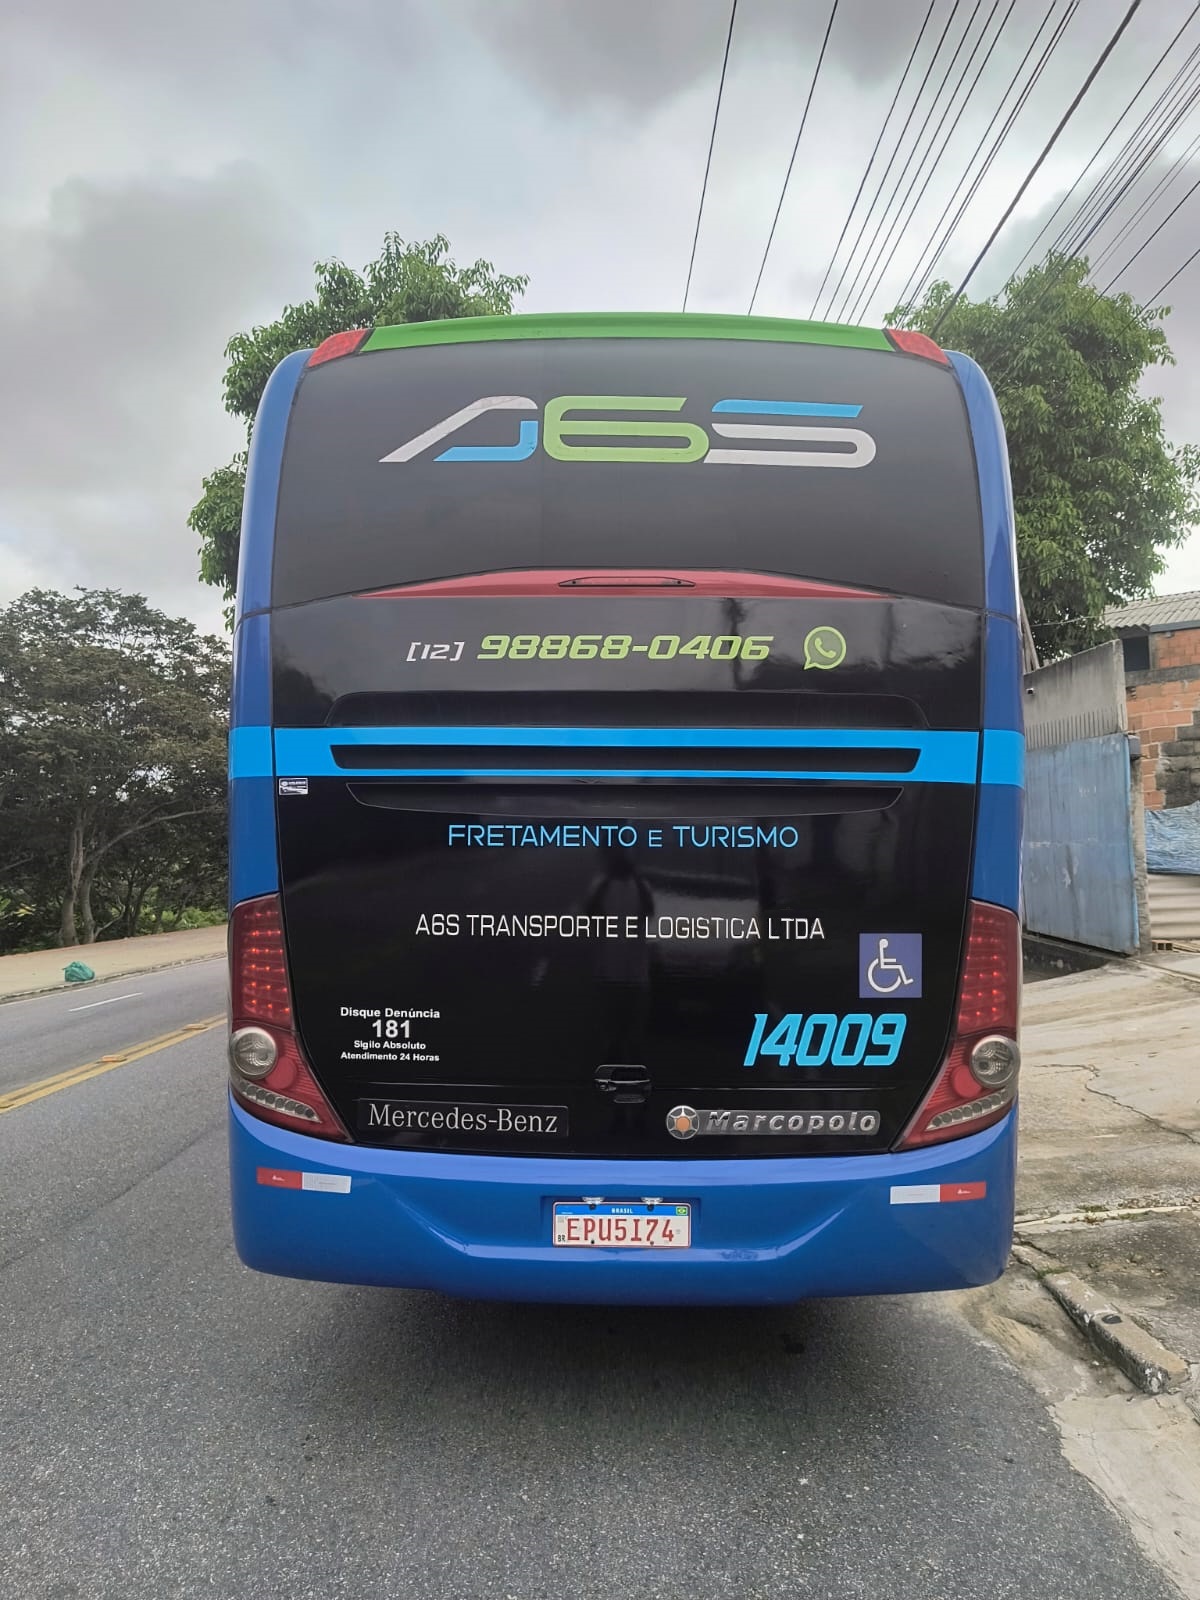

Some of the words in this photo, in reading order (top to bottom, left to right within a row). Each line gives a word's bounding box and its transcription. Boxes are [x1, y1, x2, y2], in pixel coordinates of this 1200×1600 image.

[476, 635, 774, 660] 98868-0406
[448, 824, 638, 847] FRETAMENTO
[648, 829, 663, 847] E
[673, 825, 799, 848] TURISMO
[415, 913, 460, 936] A6S
[466, 914, 619, 938] TRANSPORTE
[625, 916, 639, 938] E
[645, 916, 761, 939] LOGISTICA
[768, 917, 825, 940] LTDA
[340, 1007, 381, 1019] Disque
[385, 1008, 441, 1018] Denúncia
[372, 1019, 410, 1038] 181
[744, 1013, 907, 1067] 14009
[340, 1051, 398, 1060] Atendimento
[400, 1053, 410, 1061] 24
[413, 1053, 440, 1061] Horas
[353, 1040, 381, 1050] Sigilo
[383, 1041, 426, 1050] Absoluto
[367, 1103, 558, 1134] Mercedes-Benz
[706, 1111, 877, 1134] Marcopolo
[557, 1234, 566, 1242] BR
[567, 1218, 674, 1242] EPU5I74
